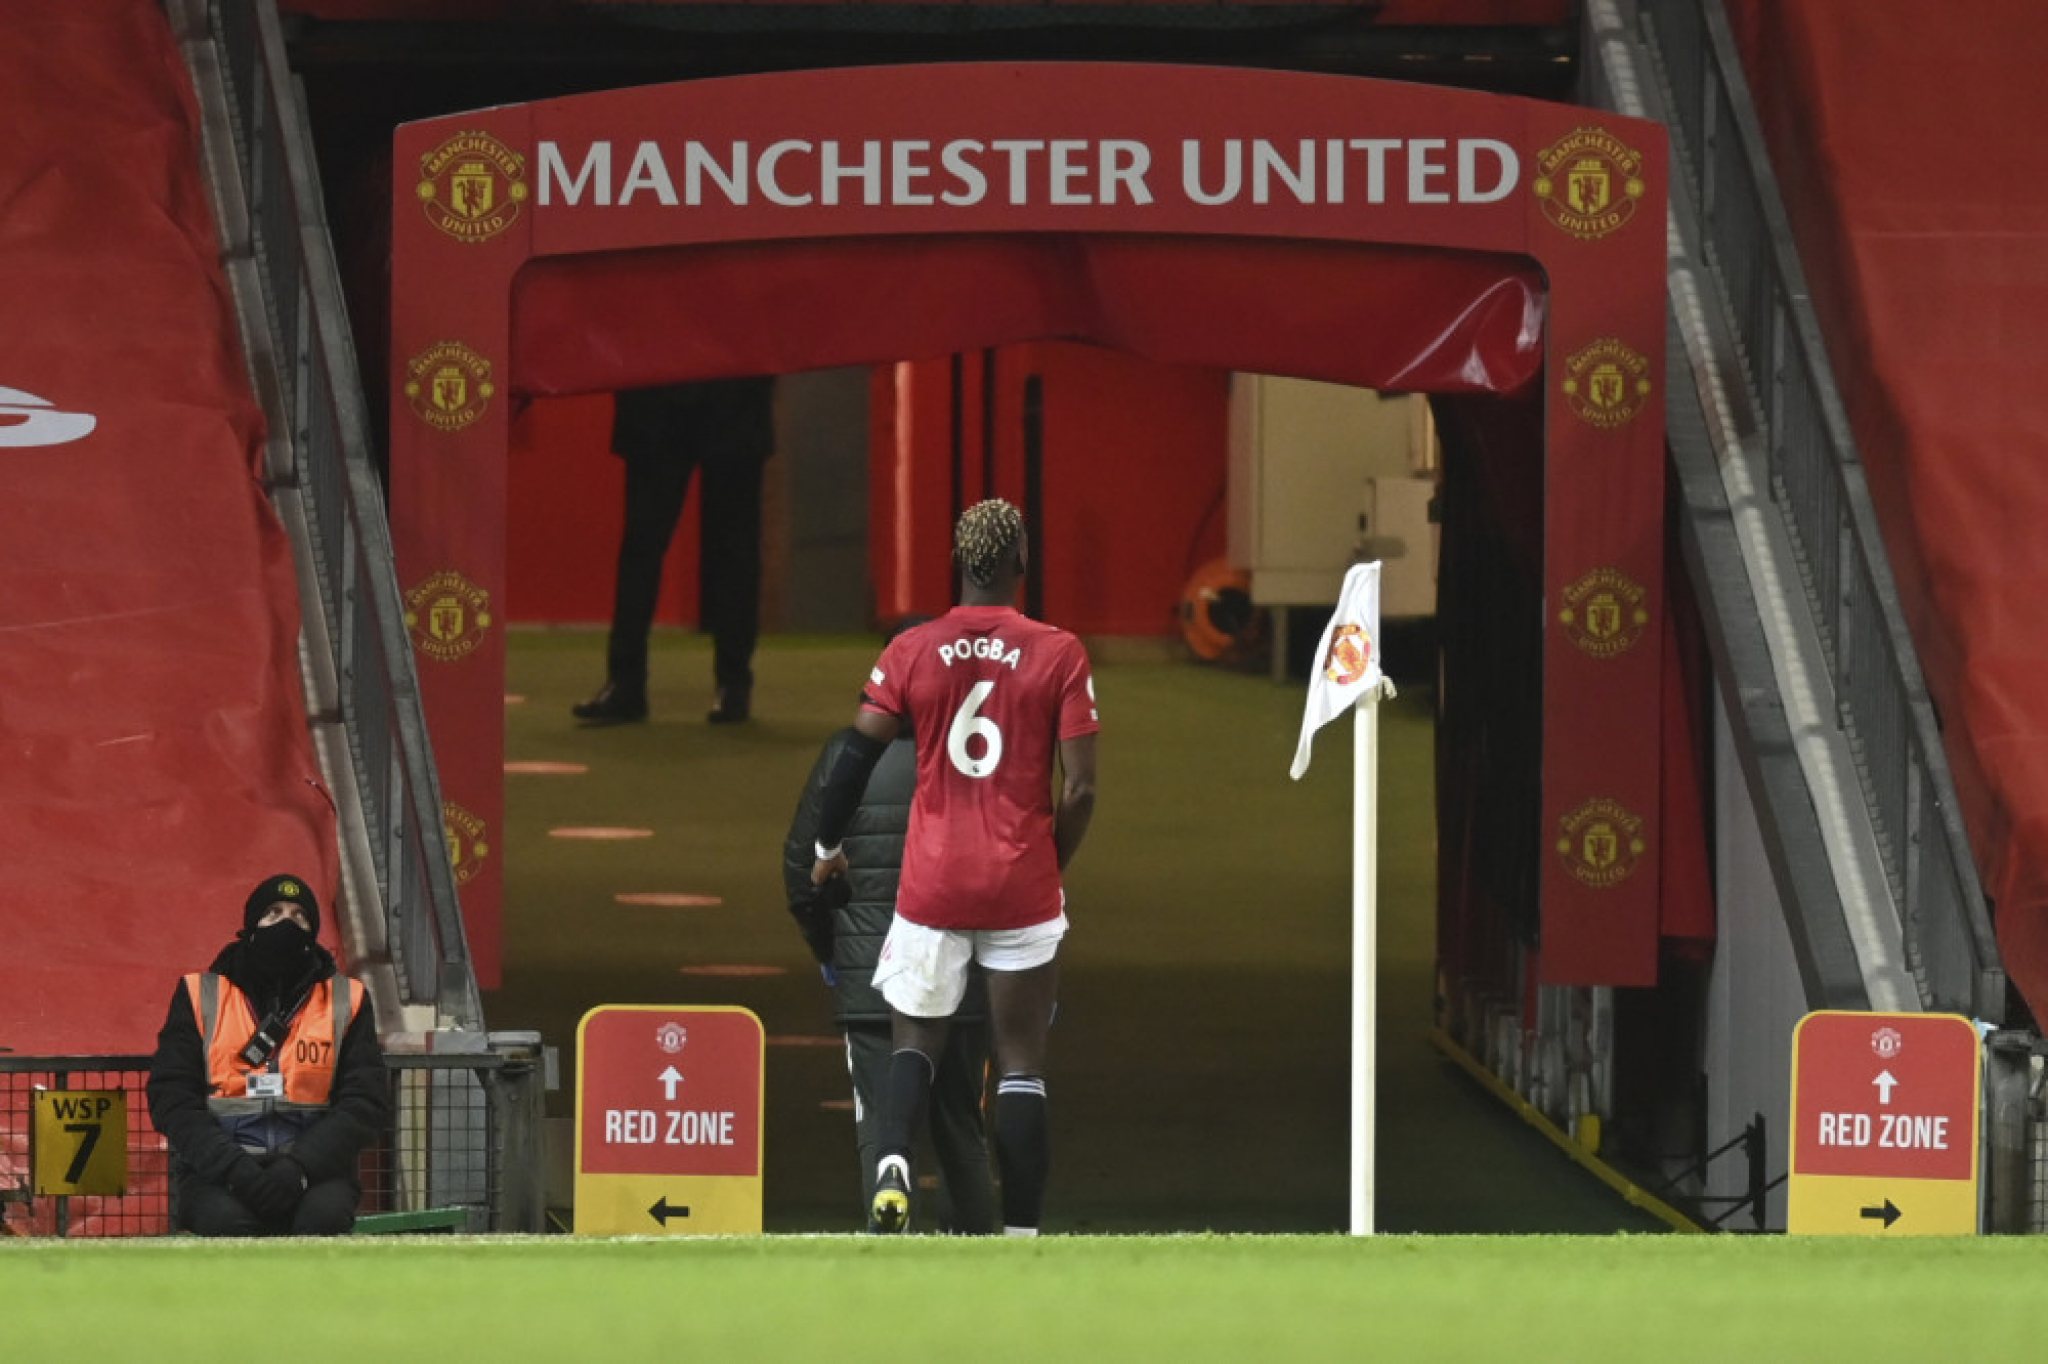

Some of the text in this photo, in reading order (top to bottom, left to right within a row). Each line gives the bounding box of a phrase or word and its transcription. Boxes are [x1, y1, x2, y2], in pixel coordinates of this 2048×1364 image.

[428, 138, 517, 175] MANCHESTER
[1545, 134, 1633, 171] MANCHESTER
[537, 138, 1521, 206] MANCHESTER UNITED
[441, 216, 503, 235] UNITED
[1558, 212, 1619, 231] UNITED
[937, 637, 1021, 670] POGBA
[947, 679, 1003, 779] 6
[297, 1040, 332, 1064] 007
[52, 1097, 112, 1119] WSP
[605, 1109, 735, 1146] RED ZONE
[1819, 1111, 1950, 1150] RED ZONE
[64, 1123, 102, 1184] 7
